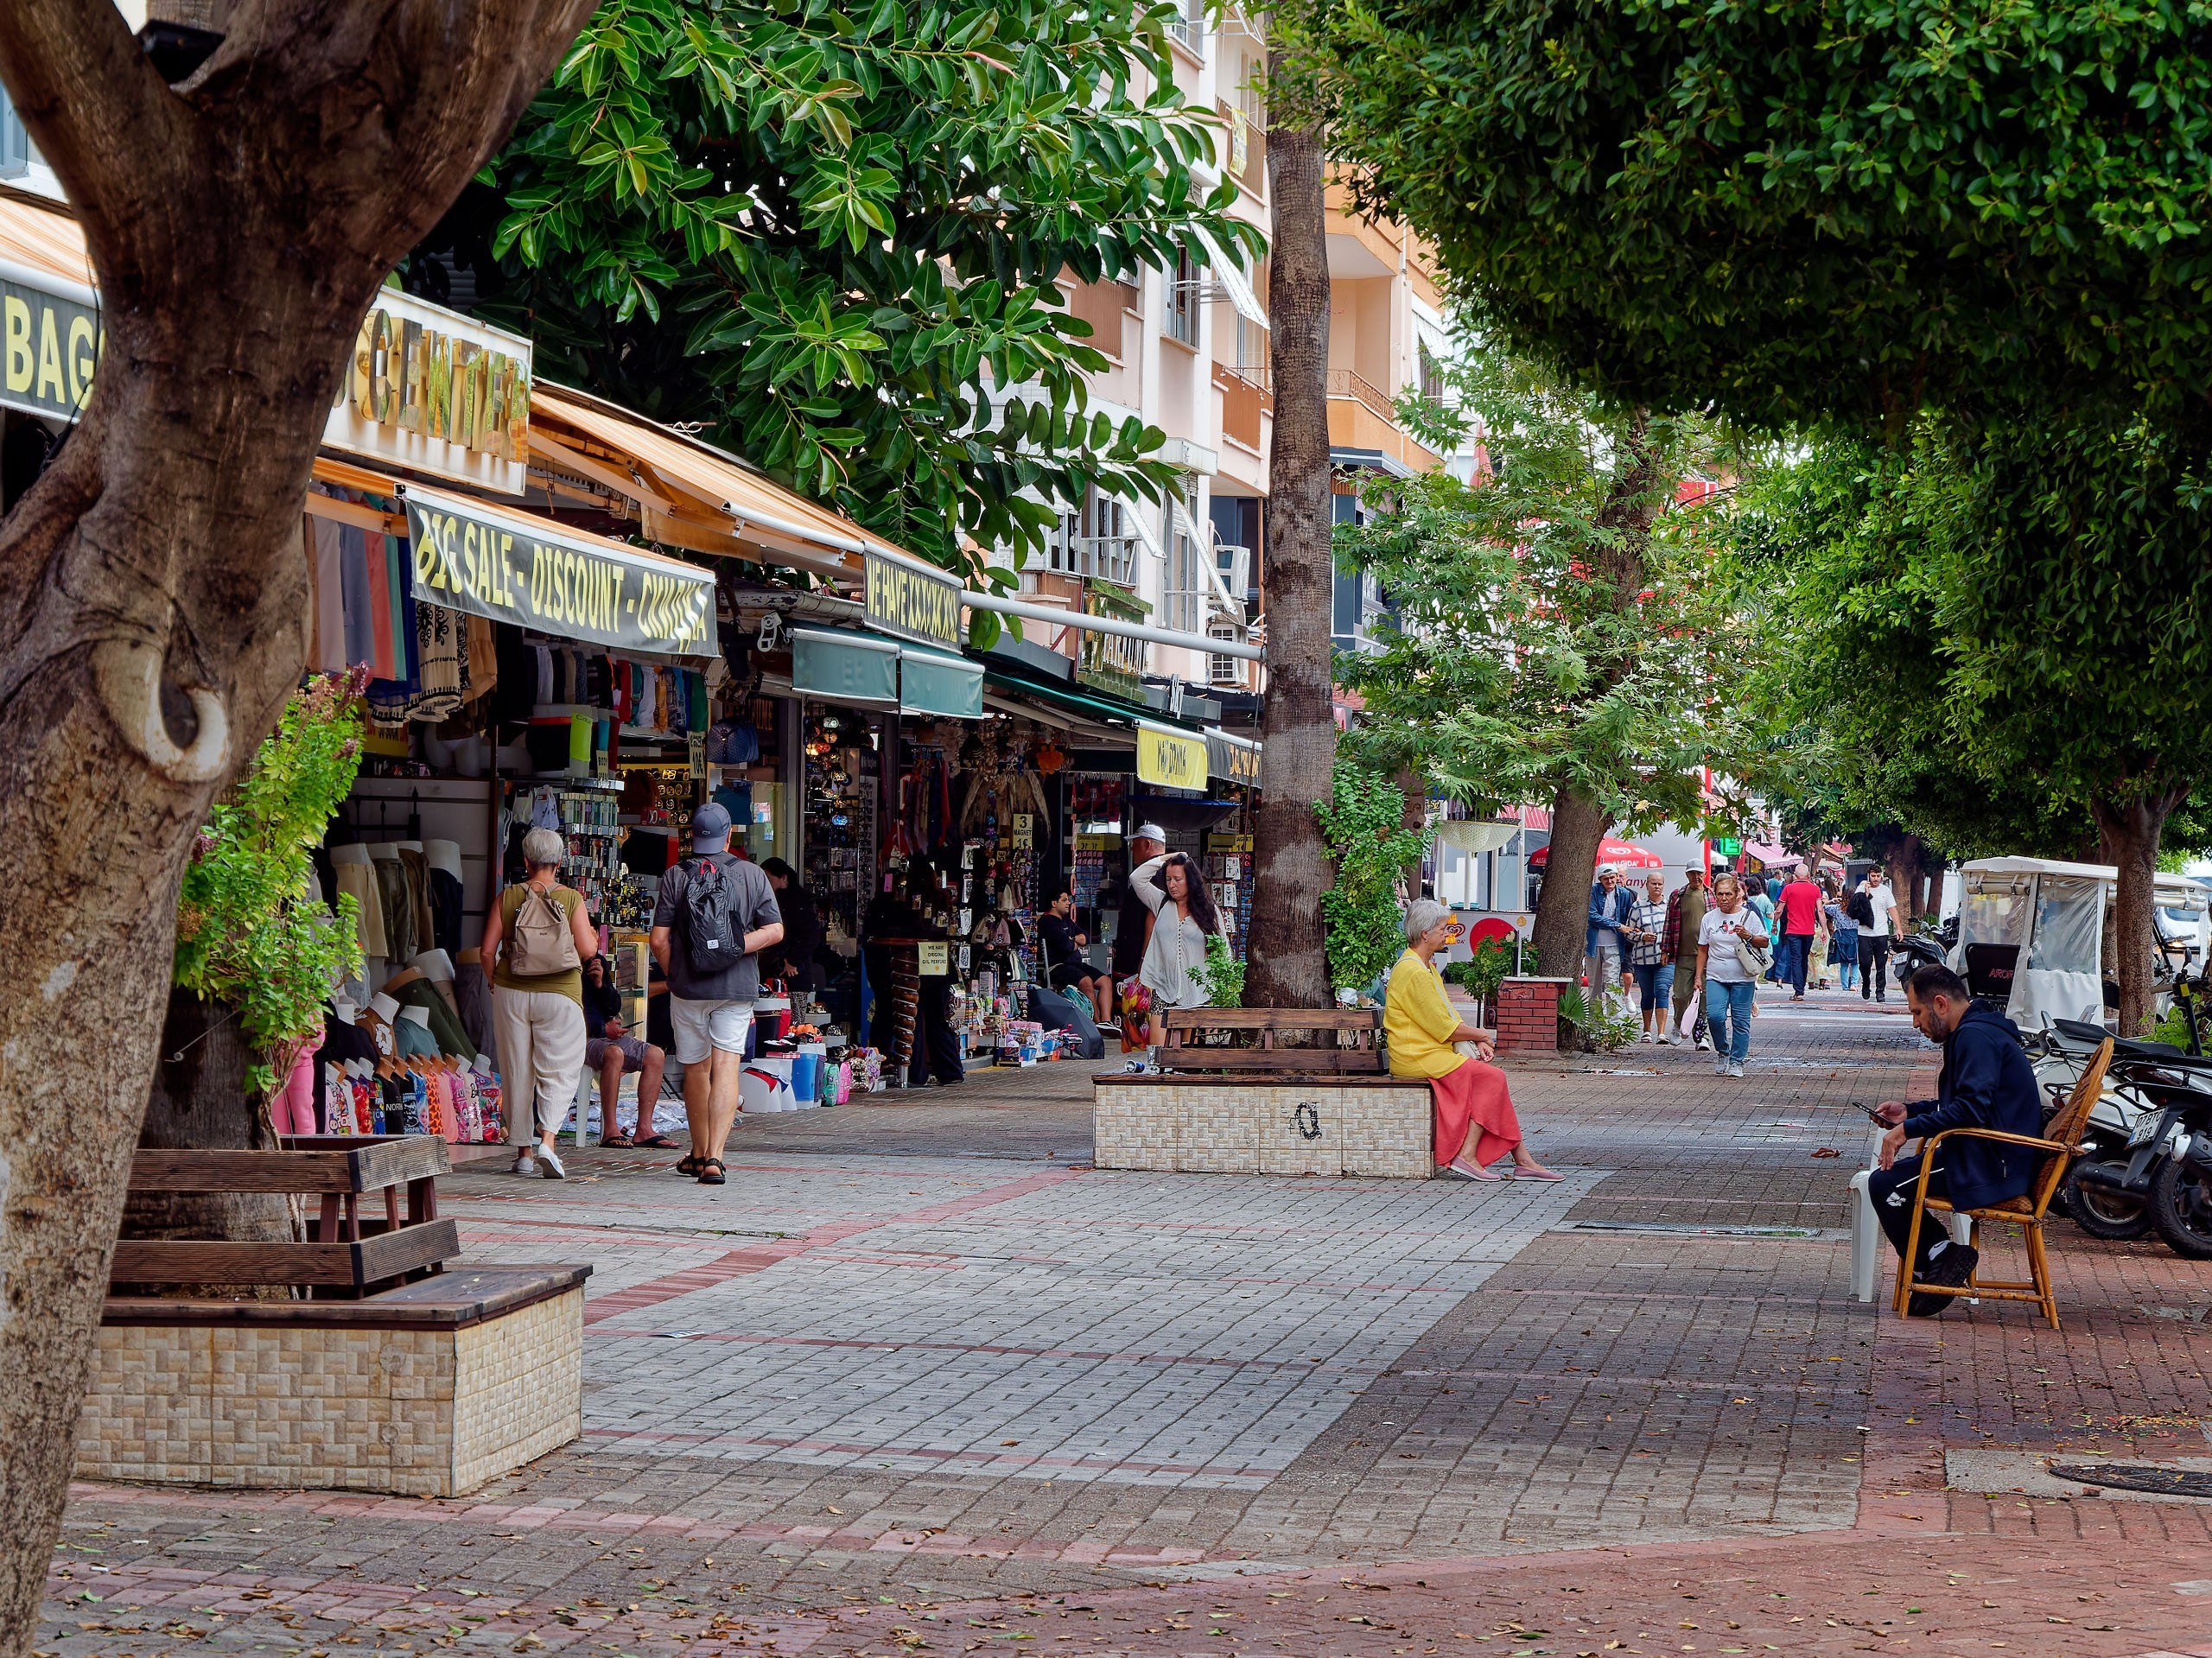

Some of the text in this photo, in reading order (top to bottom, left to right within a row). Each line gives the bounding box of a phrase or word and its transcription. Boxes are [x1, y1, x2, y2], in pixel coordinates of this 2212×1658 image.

[4, 295, 106, 411] BAG
[463, 521, 514, 608] SALE
[530, 543, 625, 633] DISCOUNT
[866, 556, 880, 617] WE
[882, 564, 907, 626] HAVE
[1019, 815, 1027, 829] 3
